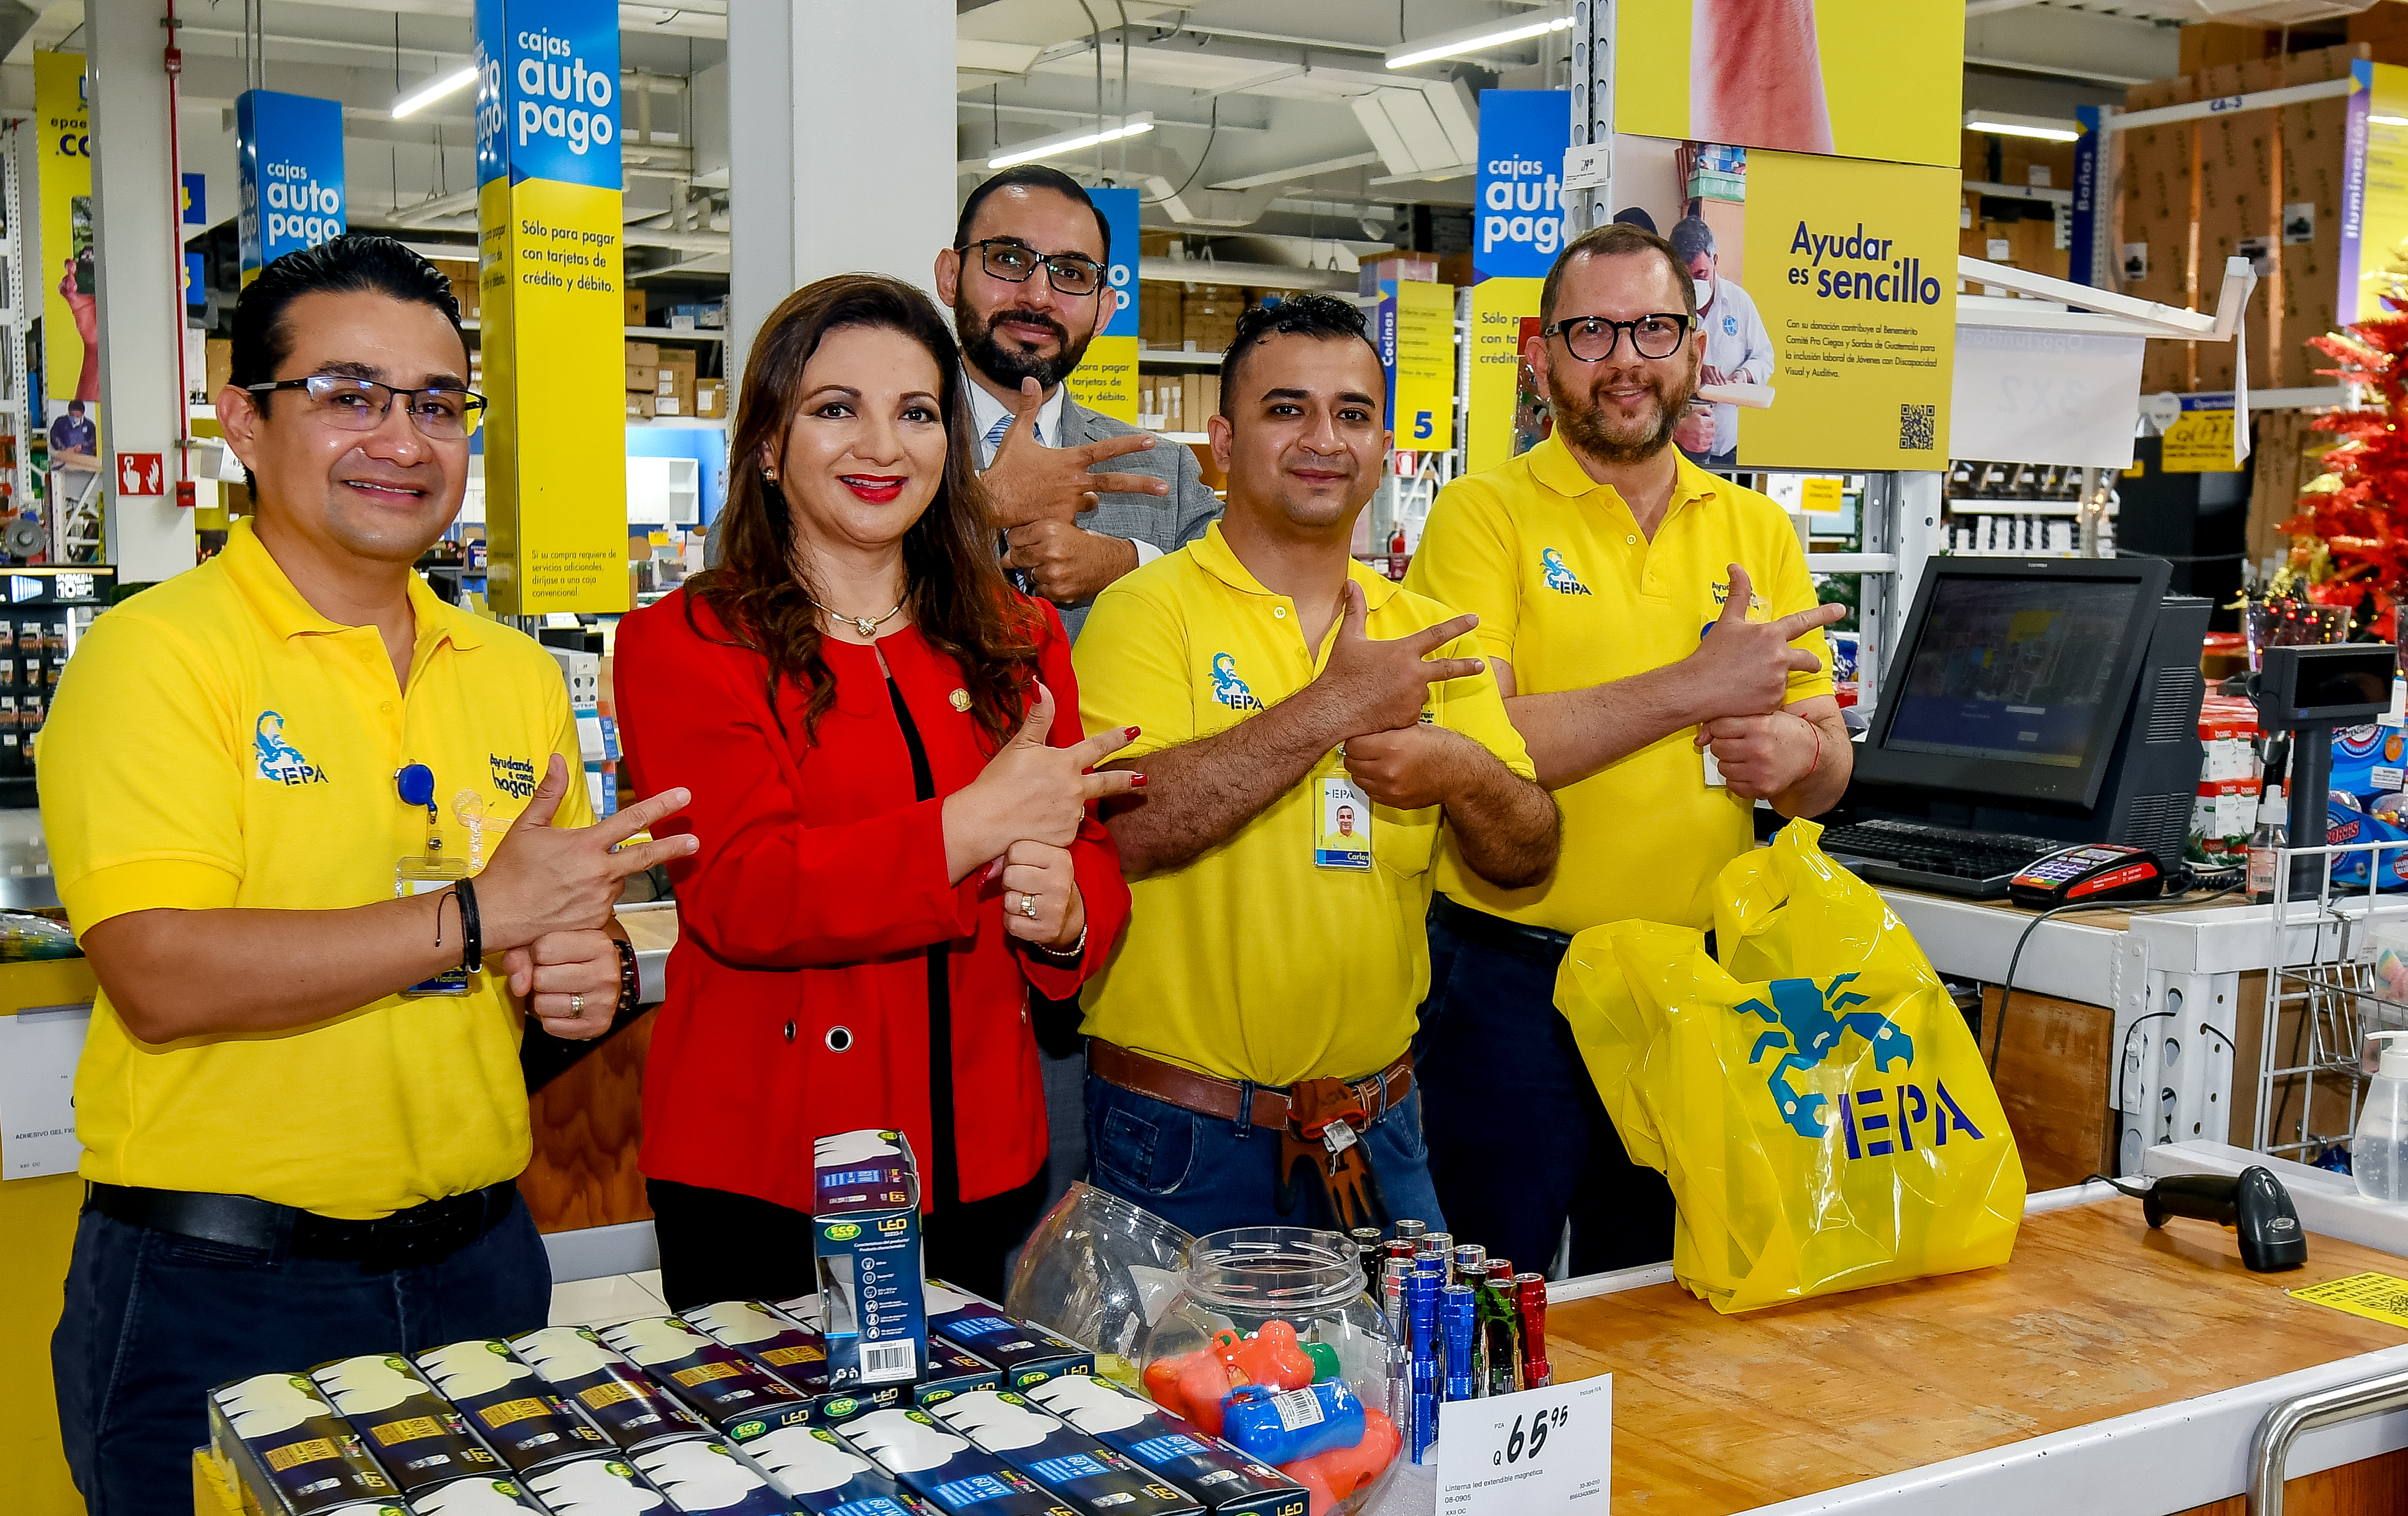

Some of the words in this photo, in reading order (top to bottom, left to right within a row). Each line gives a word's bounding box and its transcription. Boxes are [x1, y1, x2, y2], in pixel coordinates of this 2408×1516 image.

[518, 27, 571, 60] cajas
[518, 57, 612, 108] auto
[519, 100, 613, 155] pago
[267, 159, 307, 183] cajas
[1488, 153, 1543, 181] cajas
[267, 179, 339, 214] auto
[1485, 174, 1564, 211] aut
[268, 213, 340, 248] pago
[521, 220, 547, 236] Sólo
[551, 227, 578, 241] para
[582, 231, 615, 247] pagar
[1483, 216, 1564, 254] pag
[1790, 220, 1893, 267] Ayudar
[523, 248, 543, 261] con
[547, 249, 589, 268] tarjetas
[593, 252, 606, 267] de
[523, 270, 562, 287] crédito
[567, 278, 574, 292] y
[577, 274, 615, 293] débito.
[1788, 268, 1809, 285] es
[1817, 257, 1940, 305] sencillo
[1482, 312, 1507, 323] Sólo
[1786, 319, 1799, 328] Con
[1876, 325, 1882, 333] al
[1382, 312, 1394, 367] Cocinas
[1481, 335, 1501, 343] con
[1810, 337, 1820, 346] Pro
[1875, 340, 1883, 349] de
[1885, 341, 1918, 351] Guatemala
[1785, 350, 1792, 359] la
[1793, 350, 1820, 360] inclusión
[1823, 352, 1845, 362] laboral
[1847, 354, 1854, 363] de
[1101, 364, 1130, 373] pagar
[1785, 367, 1805, 375] Visual
[1110, 377, 1121, 386] de
[1413, 411, 1434, 439] 5
[532, 549, 538, 559] Si
[550, 552, 577, 561] compra
[579, 552, 606, 561] requiere
[608, 548, 616, 558] de
[532, 564, 562, 572] servicios
[582, 574, 596, 586] caja
[1560, 581, 1593, 596] EPA
[1230, 694, 1266, 712] EPA
[282, 764, 330, 786] EPA
[1332, 789, 1355, 799] EPA
[1348, 853, 1369, 861] Carlos
[1837, 1077, 1985, 1160] EPA
[15, 1131, 49, 1140] ADHESIVO
[830, 1225, 857, 1234] ECO
[878, 1218, 908, 1231] LED
[1023, 1374, 1045, 1383] ECO
[830, 1400, 854, 1409] ECO
[872, 1388, 898, 1404] LED
[928, 1391, 950, 1401] ECO
[737, 1424, 761, 1433] ECO
[781, 1409, 809, 1425] LED
[1493, 1450, 1502, 1466] Q
[1507, 1409, 1548, 1463] 65
[1551, 1405, 1568, 1429] 95
[1445, 1483, 1471, 1492] Linterna
[1473, 1479, 1482, 1488] led
[1483, 1474, 1513, 1487] extendible
[1515, 1469, 1543, 1480] magnetica
[1145, 1483, 1179, 1500] LED
[1444, 1494, 1471, 1504] 08-0905
[1275, 1501, 1303, 1516] LED
